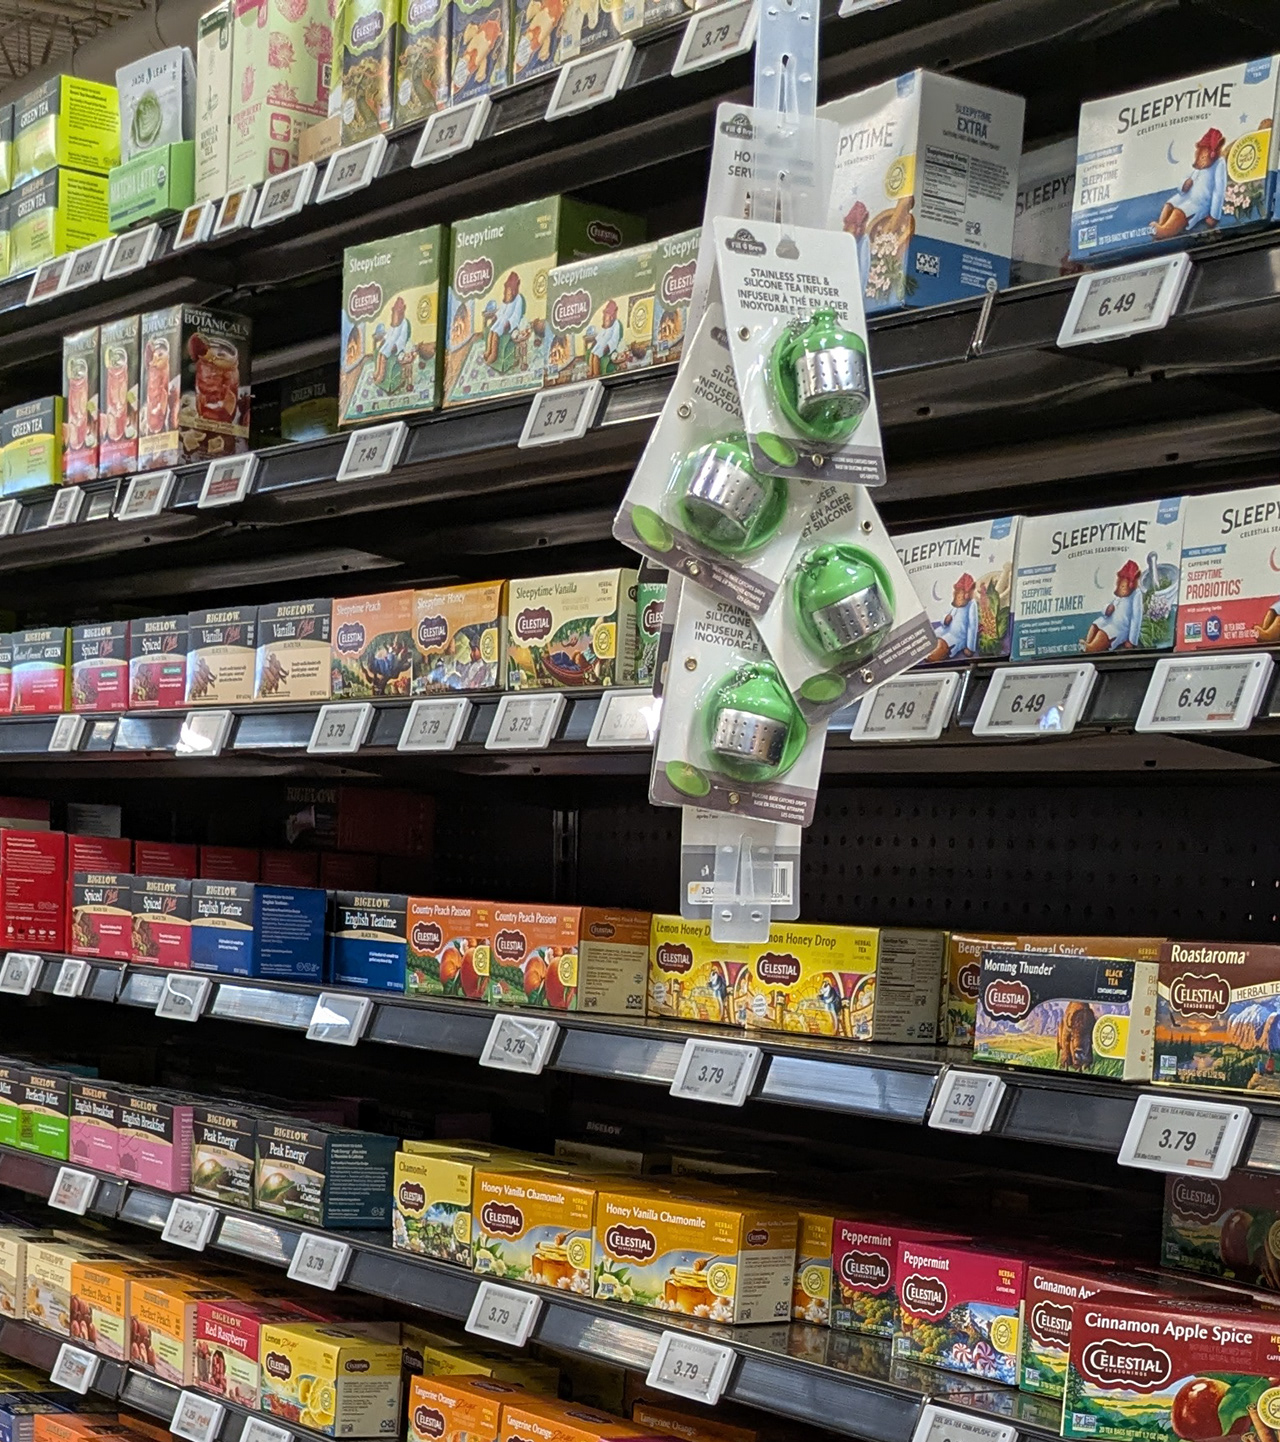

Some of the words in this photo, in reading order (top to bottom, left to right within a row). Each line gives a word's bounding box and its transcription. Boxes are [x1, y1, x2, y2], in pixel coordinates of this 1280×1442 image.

[1117, 83, 1231, 134] SLEEPYTIME
[457, 226, 504, 250] Sleepytime
[743, 277, 783, 290] SILICONE
[785, 284, 800, 292] TEA
[803, 286, 839, 297] INFUSER
[750, 268, 794, 282] STAINLESS
[797, 274, 822, 285] STEEL
[823, 277, 830, 286] &
[1098, 293, 1136, 318] 6.49
[358, 446, 378, 463] 7.49
[277, 603, 314, 617] BIGELOW
[420, 720, 440, 735] 3.79
[354, 897, 390, 908] BIGELOW
[345, 912, 369, 929] English
[371, 915, 397, 928] Teatime
[1171, 944, 1246, 966] Roastaroma
[698, 1065, 724, 1085] 3.79
[1159, 1129, 1198, 1153] 3.79
[269, 1142, 286, 1158] Peak
[288, 1146, 308, 1164] Energy
[903, 1250, 950, 1272] Peppermint
[1084, 1312, 1160, 1336] Cinnamon
[1164, 1321, 1208, 1343] Apple
[1212, 1327, 1254, 1347] Spice
